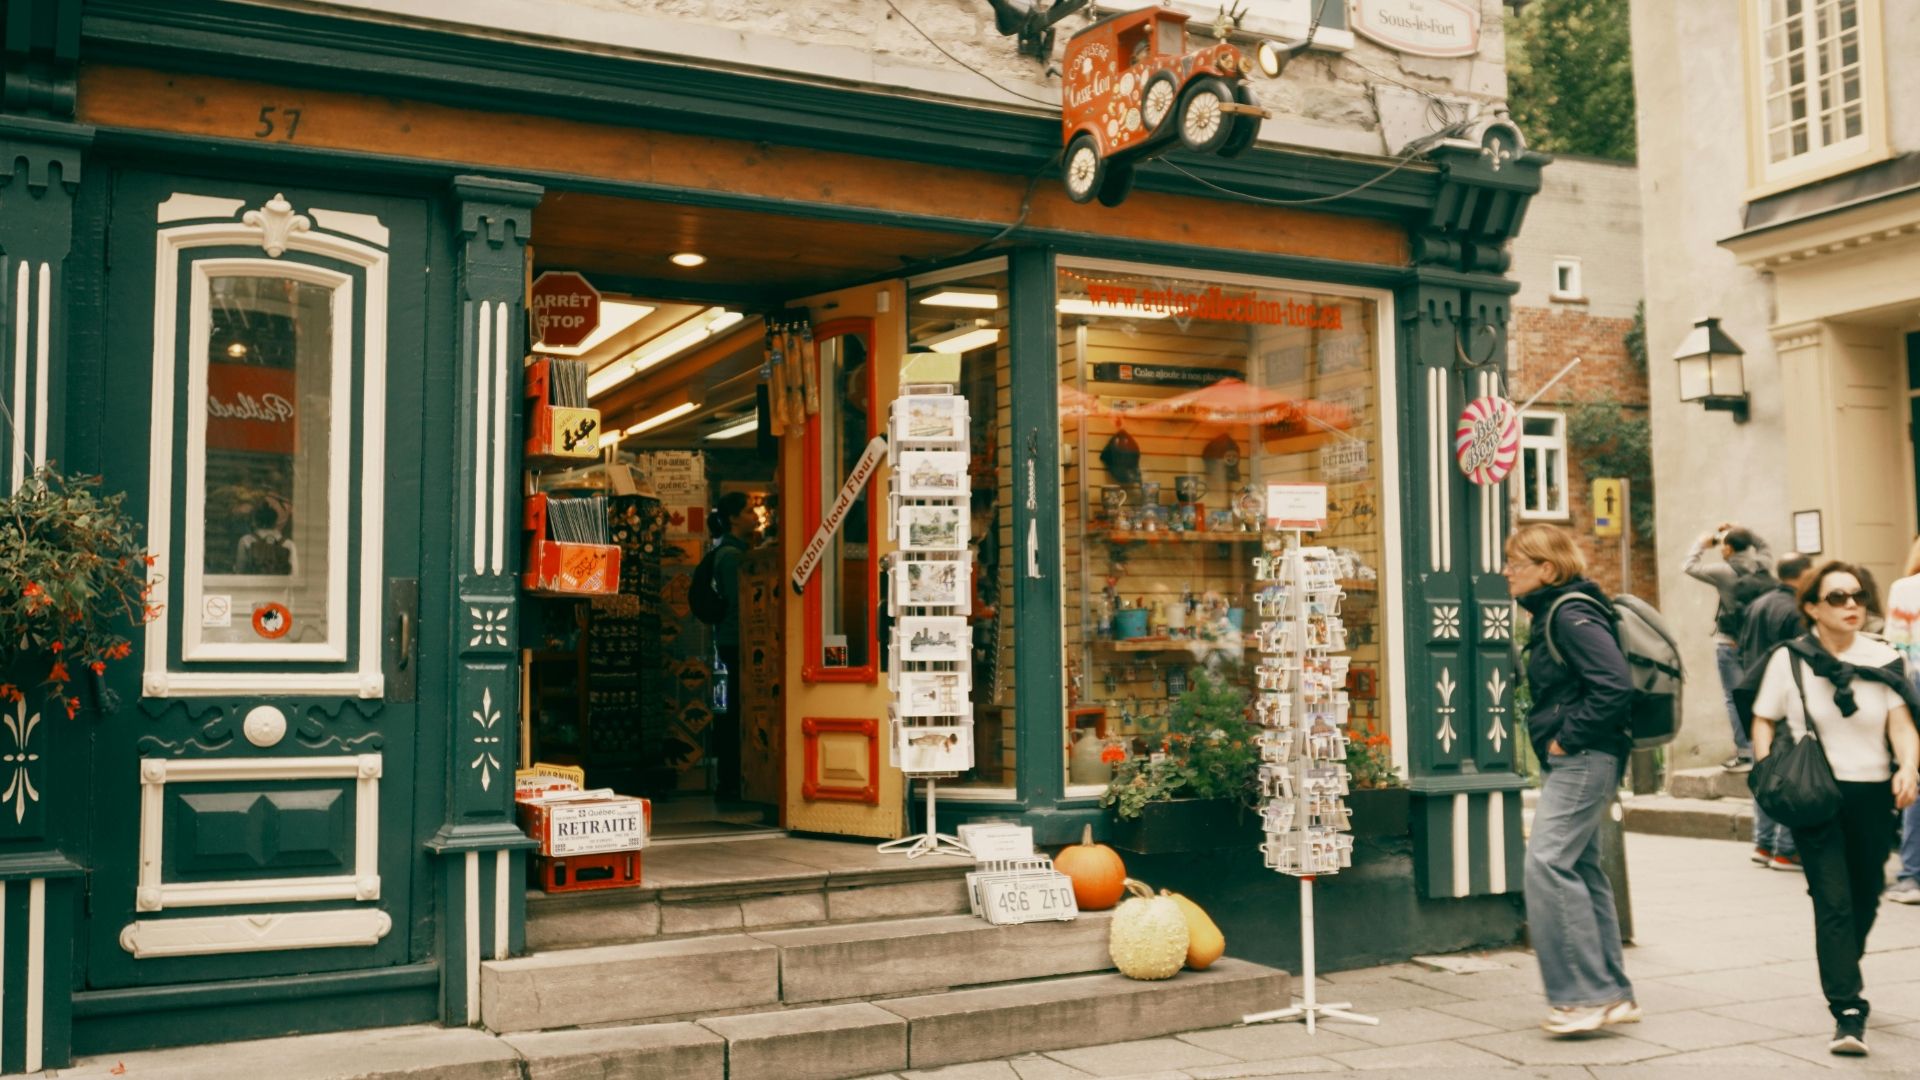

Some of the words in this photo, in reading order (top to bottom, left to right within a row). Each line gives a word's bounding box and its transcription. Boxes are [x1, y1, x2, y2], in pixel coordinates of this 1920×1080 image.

[1378, 9, 1456, 36] Sous-le-Fort
[1070, 71, 1110, 108] Casse-Cou
[255, 107, 302, 139] 57
[533, 292, 592, 308] ARRÊT
[540, 315, 585, 328] STOP
[1134, 367, 1154, 378] Coke
[1156, 369, 1180, 380] ajoute
[1473, 409, 1501, 445] Bon
[796, 538, 824, 579] Robin
[822, 494, 850, 535] Hood
[846, 452, 874, 495] Flour
[538, 769, 580, 783] WARNING
[588, 808, 617, 818] Québec
[558, 816, 637, 836] RETRAITÉ
